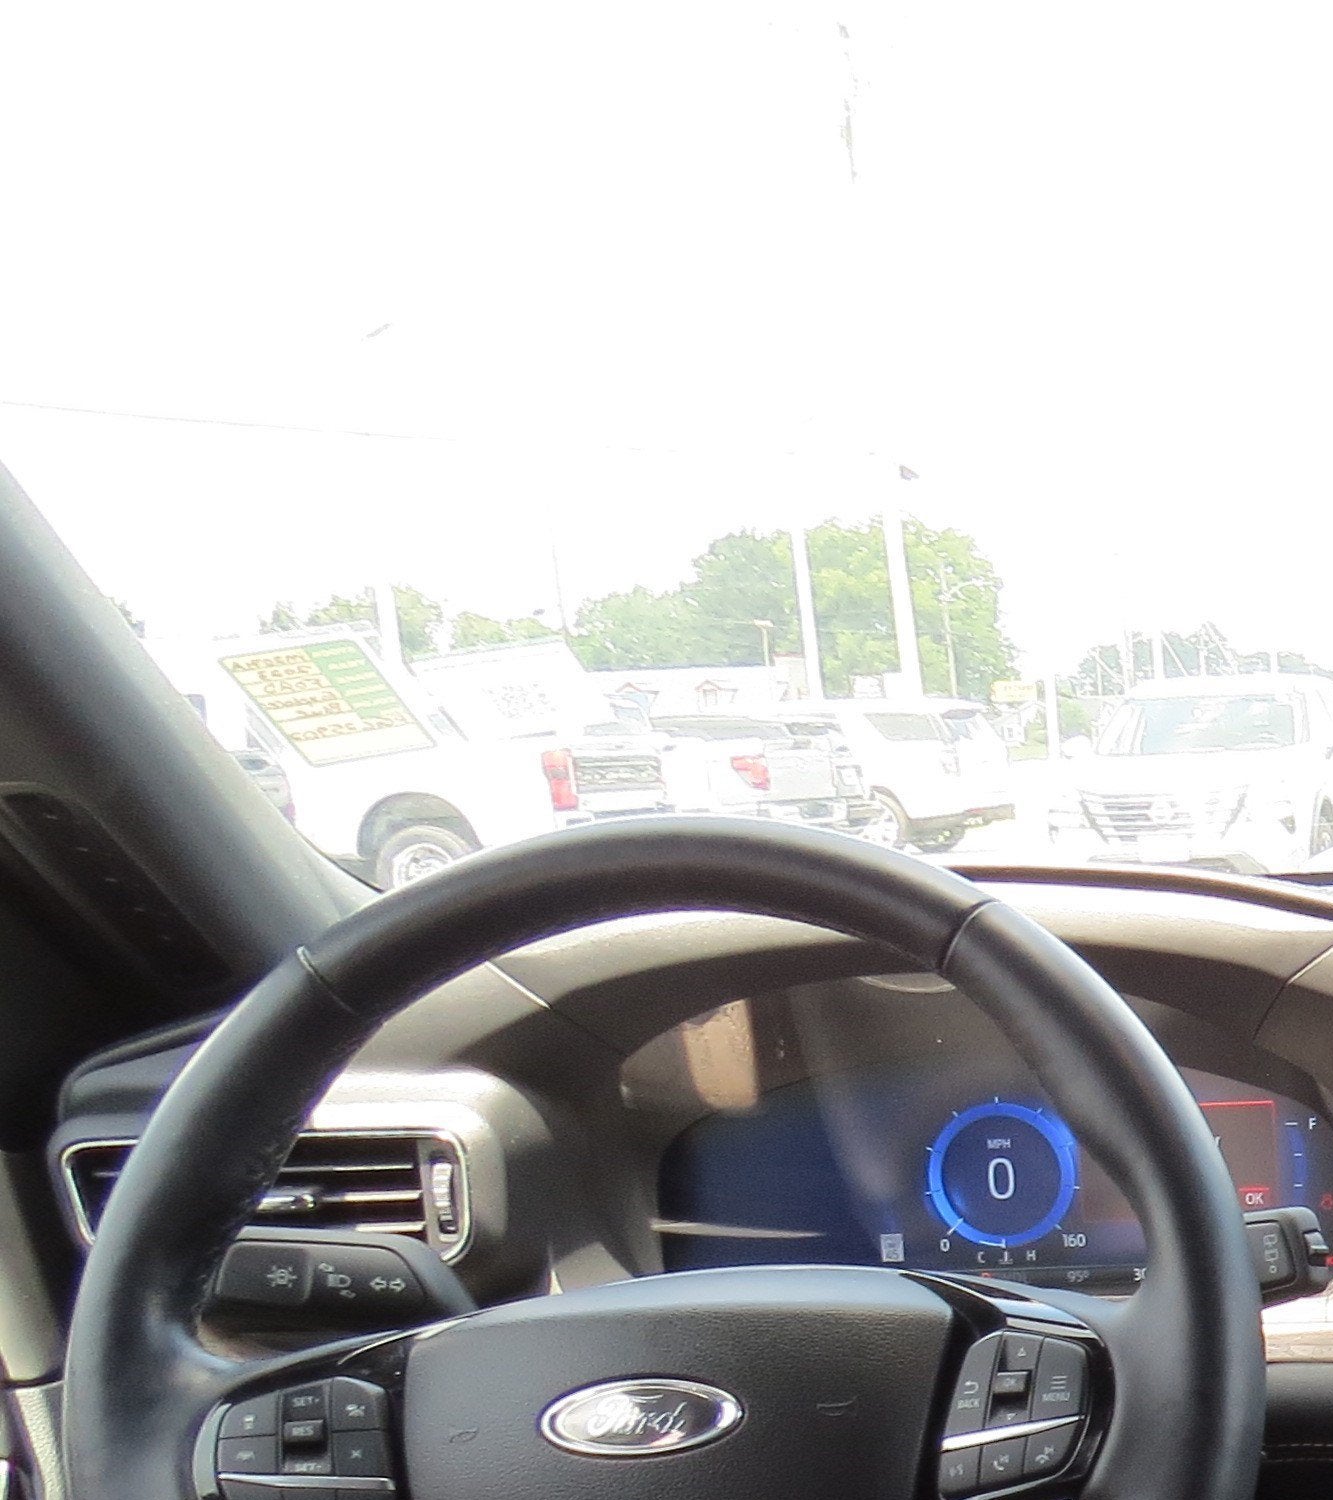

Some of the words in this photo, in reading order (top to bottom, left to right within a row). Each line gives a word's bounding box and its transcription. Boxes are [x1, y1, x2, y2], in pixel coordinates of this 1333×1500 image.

[1309, 1118, 1316, 1129] F
[987, 1139, 1010, 1149] MPH
[988, 1157, 1015, 1200] 0
[1245, 1193, 1264, 1204] OK
[940, 1239, 950, 1252] 0
[1062, 1234, 1086, 1247] 160
[977, 1252, 985, 1263] C
[1027, 1250, 1036, 1261] H
